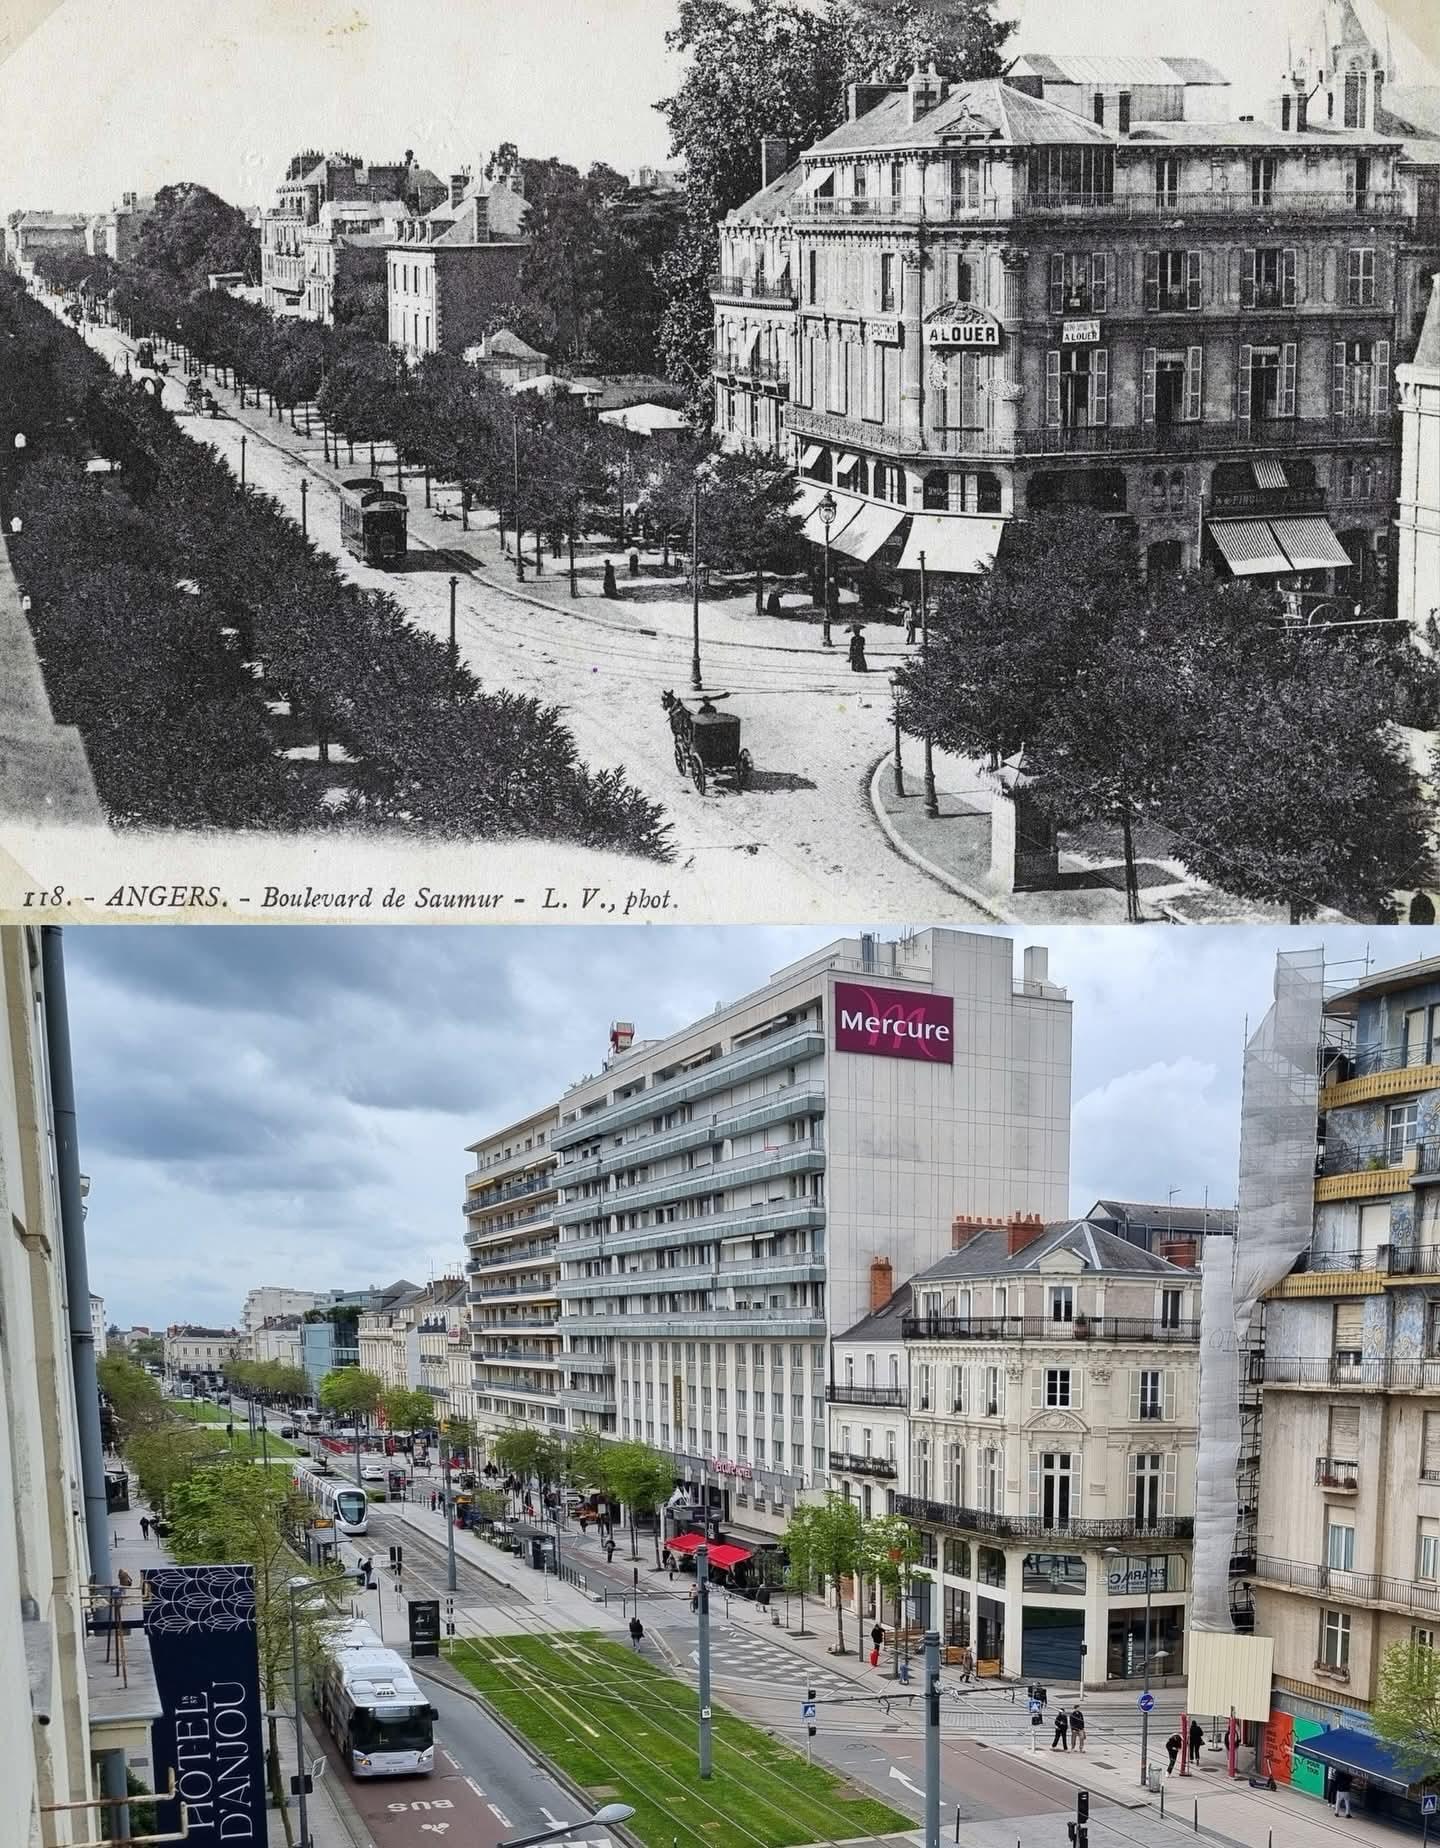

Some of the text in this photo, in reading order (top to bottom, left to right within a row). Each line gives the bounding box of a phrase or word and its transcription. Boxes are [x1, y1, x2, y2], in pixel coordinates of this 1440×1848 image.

[941, 326, 996, 342] LOUER
[841, 1009, 950, 1042] Mercure
[387, 1799, 455, 1812] BUS
